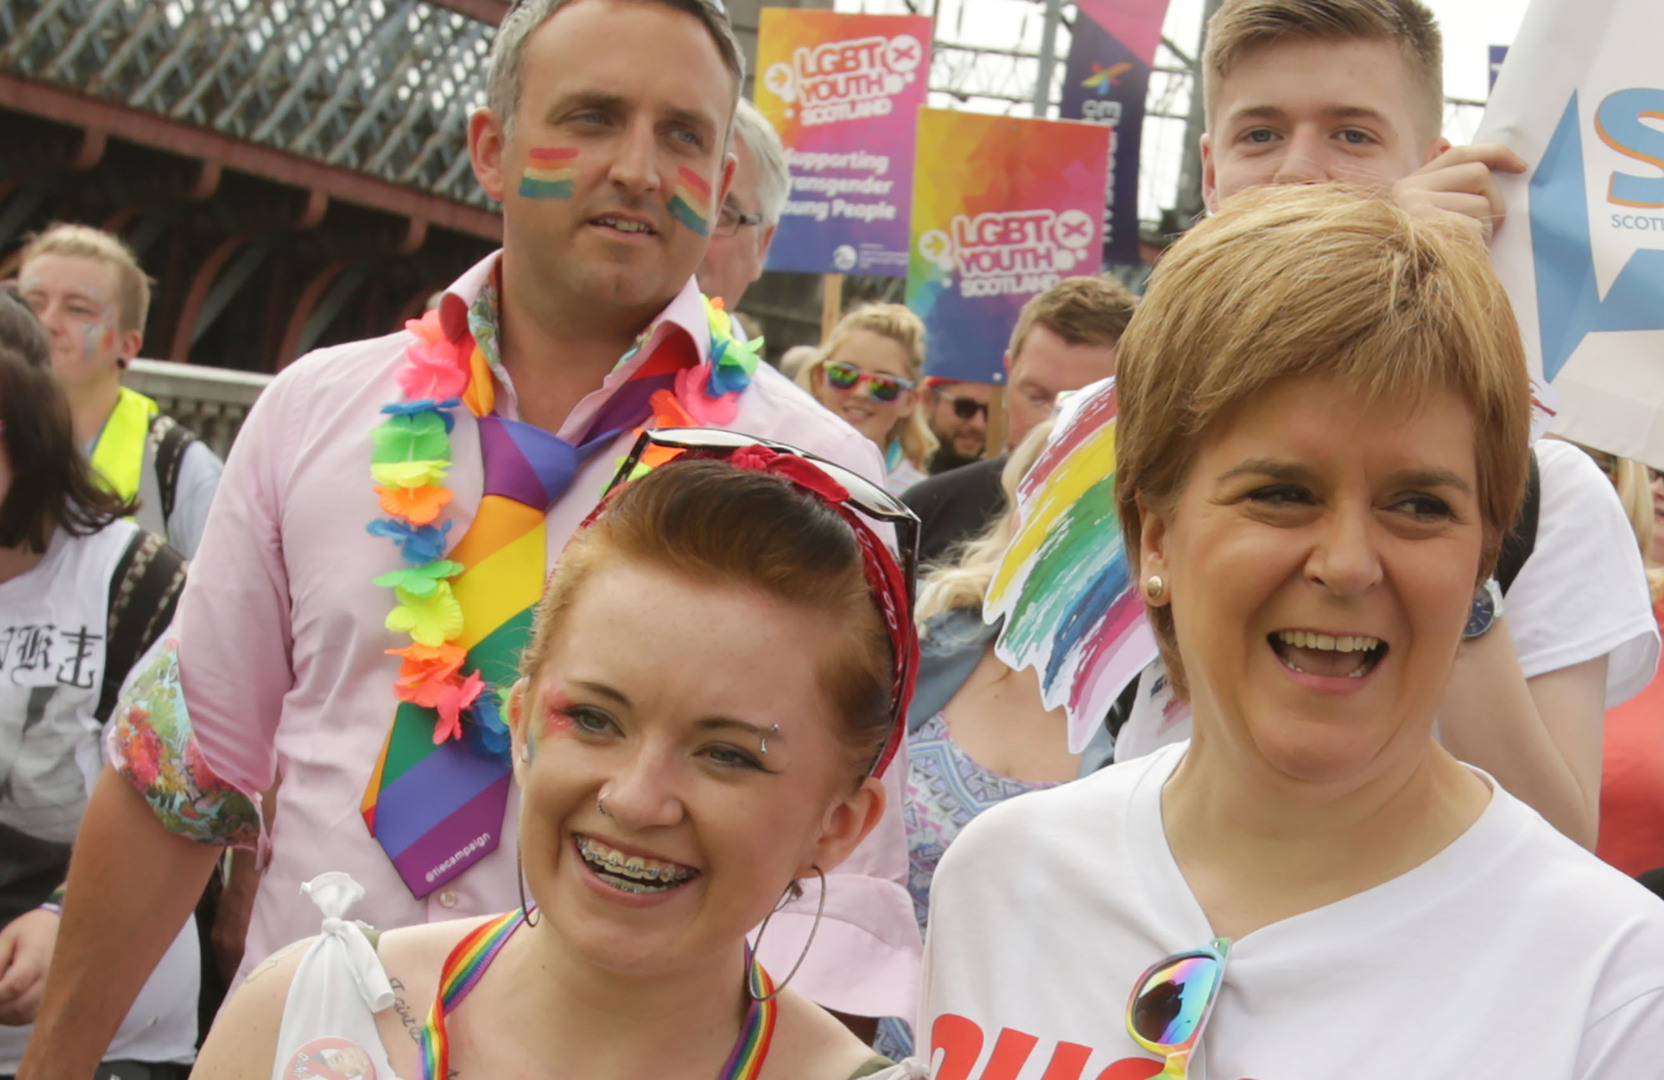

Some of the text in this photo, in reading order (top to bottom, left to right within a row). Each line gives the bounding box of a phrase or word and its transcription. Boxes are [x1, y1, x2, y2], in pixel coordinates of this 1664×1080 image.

[795, 37, 888, 80] LGBT
[800, 72, 890, 106] YOUTH
[801, 98, 893, 126] SCOTLAND
[832, 198, 897, 223] People
[954, 209, 1056, 250] LGBT
[956, 243, 1059, 279] YOUTH
[960, 272, 1062, 299] SCOTLAND
